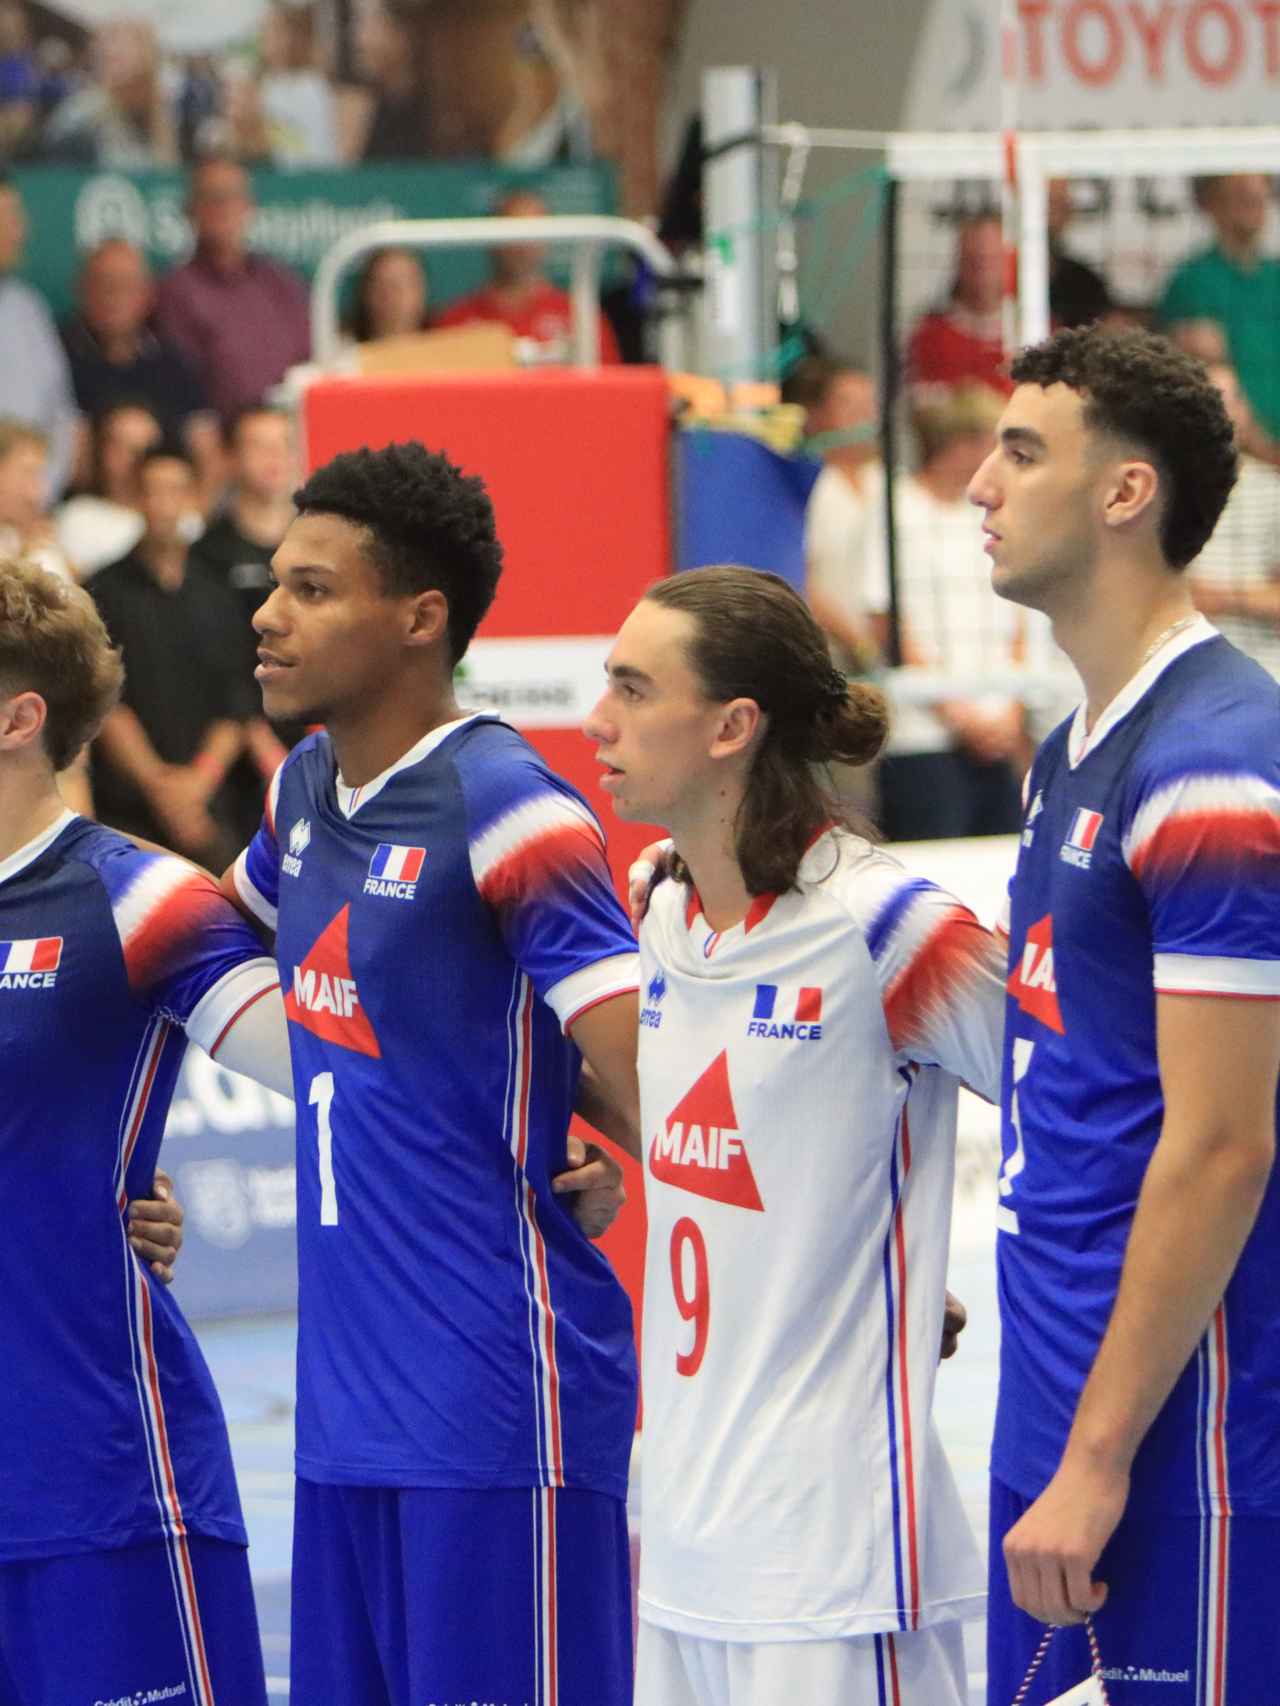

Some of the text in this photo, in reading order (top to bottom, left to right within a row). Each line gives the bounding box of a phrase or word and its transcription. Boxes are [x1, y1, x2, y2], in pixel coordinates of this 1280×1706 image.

[1060, 844, 1092, 869] NCE
[363, 877, 417, 900] FRANCE
[293, 966, 359, 1018] MAIF
[747, 1021, 822, 1041] FRANCE
[308, 1071, 339, 1226] 1
[654, 1121, 742, 1170] MAIF
[670, 1216, 711, 1378] 9
[1139, 1668, 1190, 1682] Mutuel
[147, 1682, 186, 1702] Mutuel
